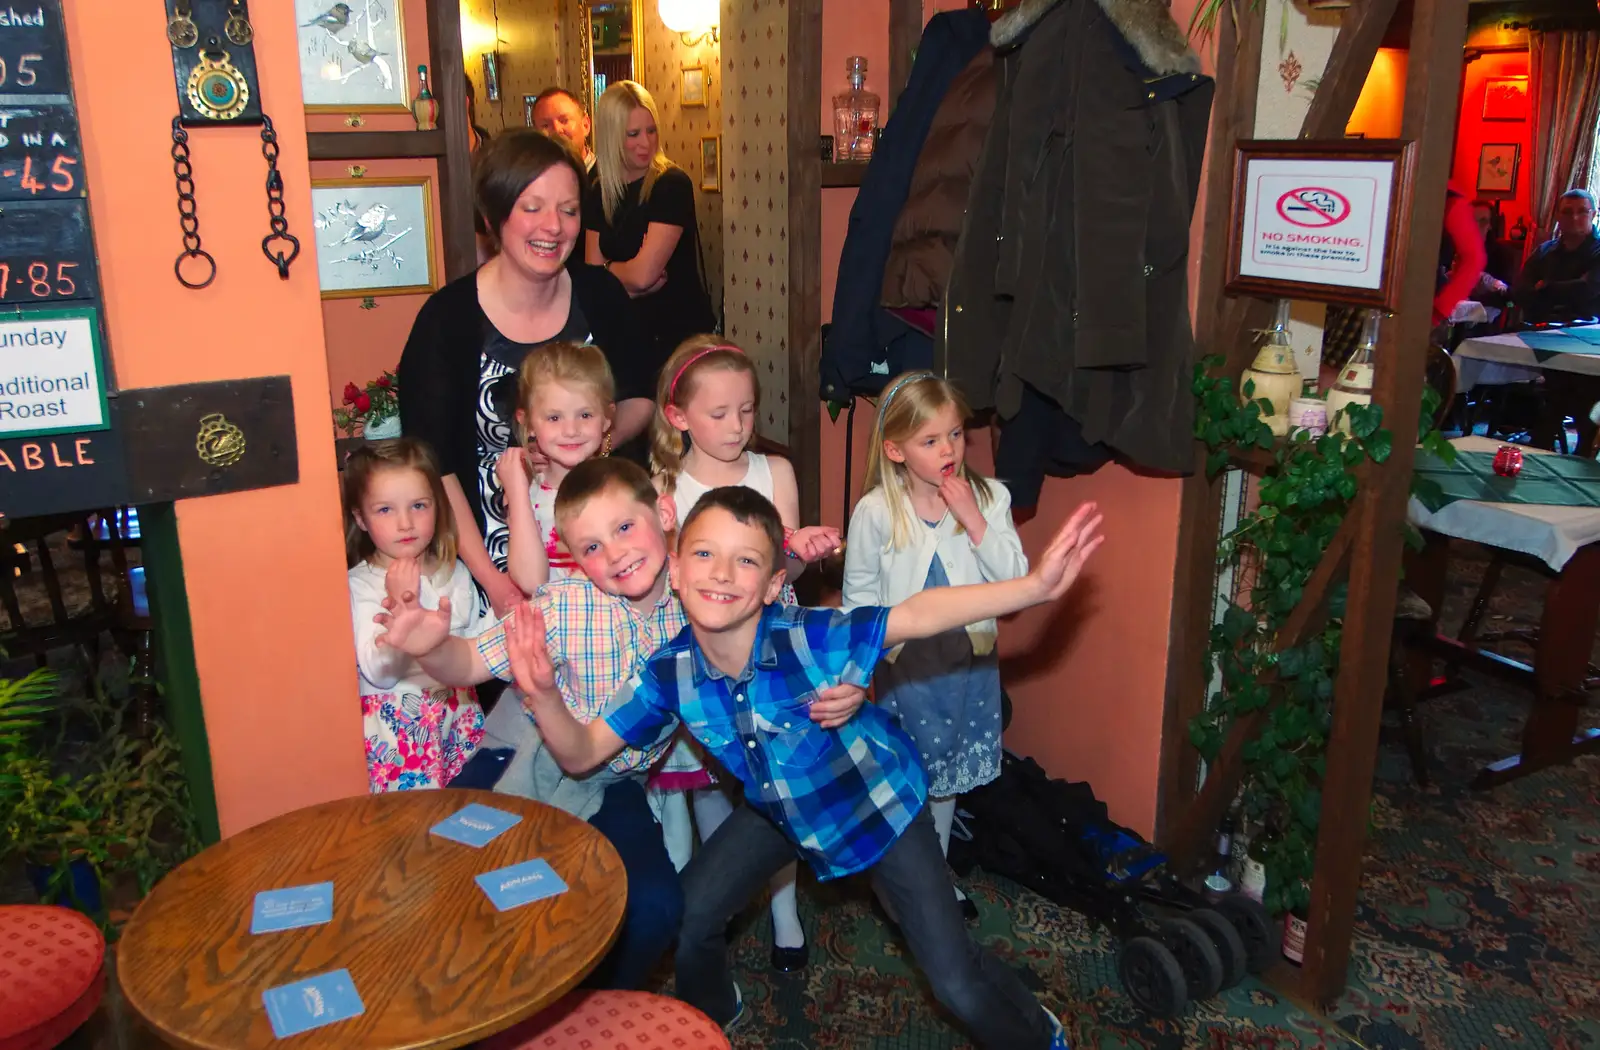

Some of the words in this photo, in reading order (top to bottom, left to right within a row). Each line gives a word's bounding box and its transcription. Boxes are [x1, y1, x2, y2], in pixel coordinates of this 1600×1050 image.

[0, 6, 44, 27] shed
[22, 132, 42, 147] IN
[51, 132, 67, 146] A
[1262, 232, 1283, 241] NO
[1282, 245, 1311, 253] against
[0, 398, 68, 419] Roast
[0, 438, 95, 472] ABLE
